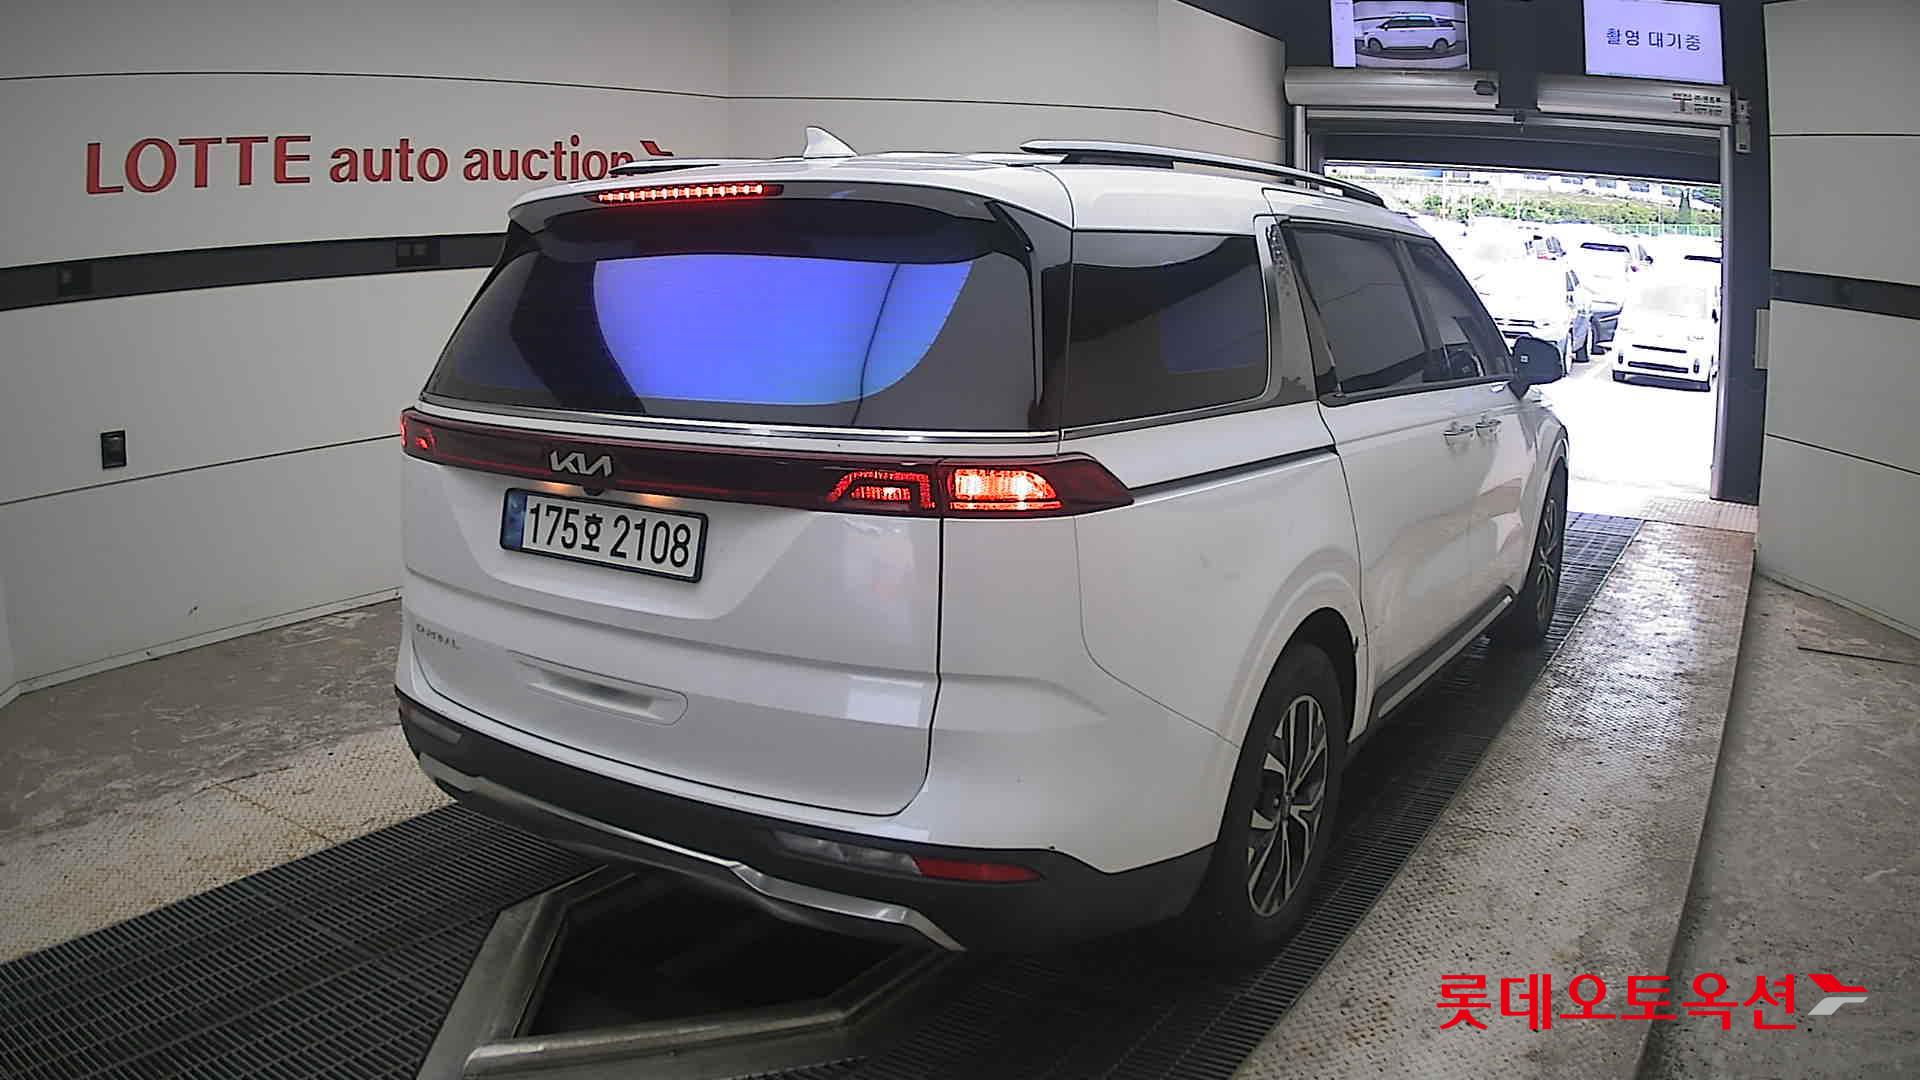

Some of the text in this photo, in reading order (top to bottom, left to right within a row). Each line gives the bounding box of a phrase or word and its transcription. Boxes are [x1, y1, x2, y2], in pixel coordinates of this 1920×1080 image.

[1606, 27, 1701, 51] 촬영 대기중
[86, 135, 310, 194] LOTTE
[329, 138, 448, 183] auto
[529, 502, 692, 568] 175호 2108
